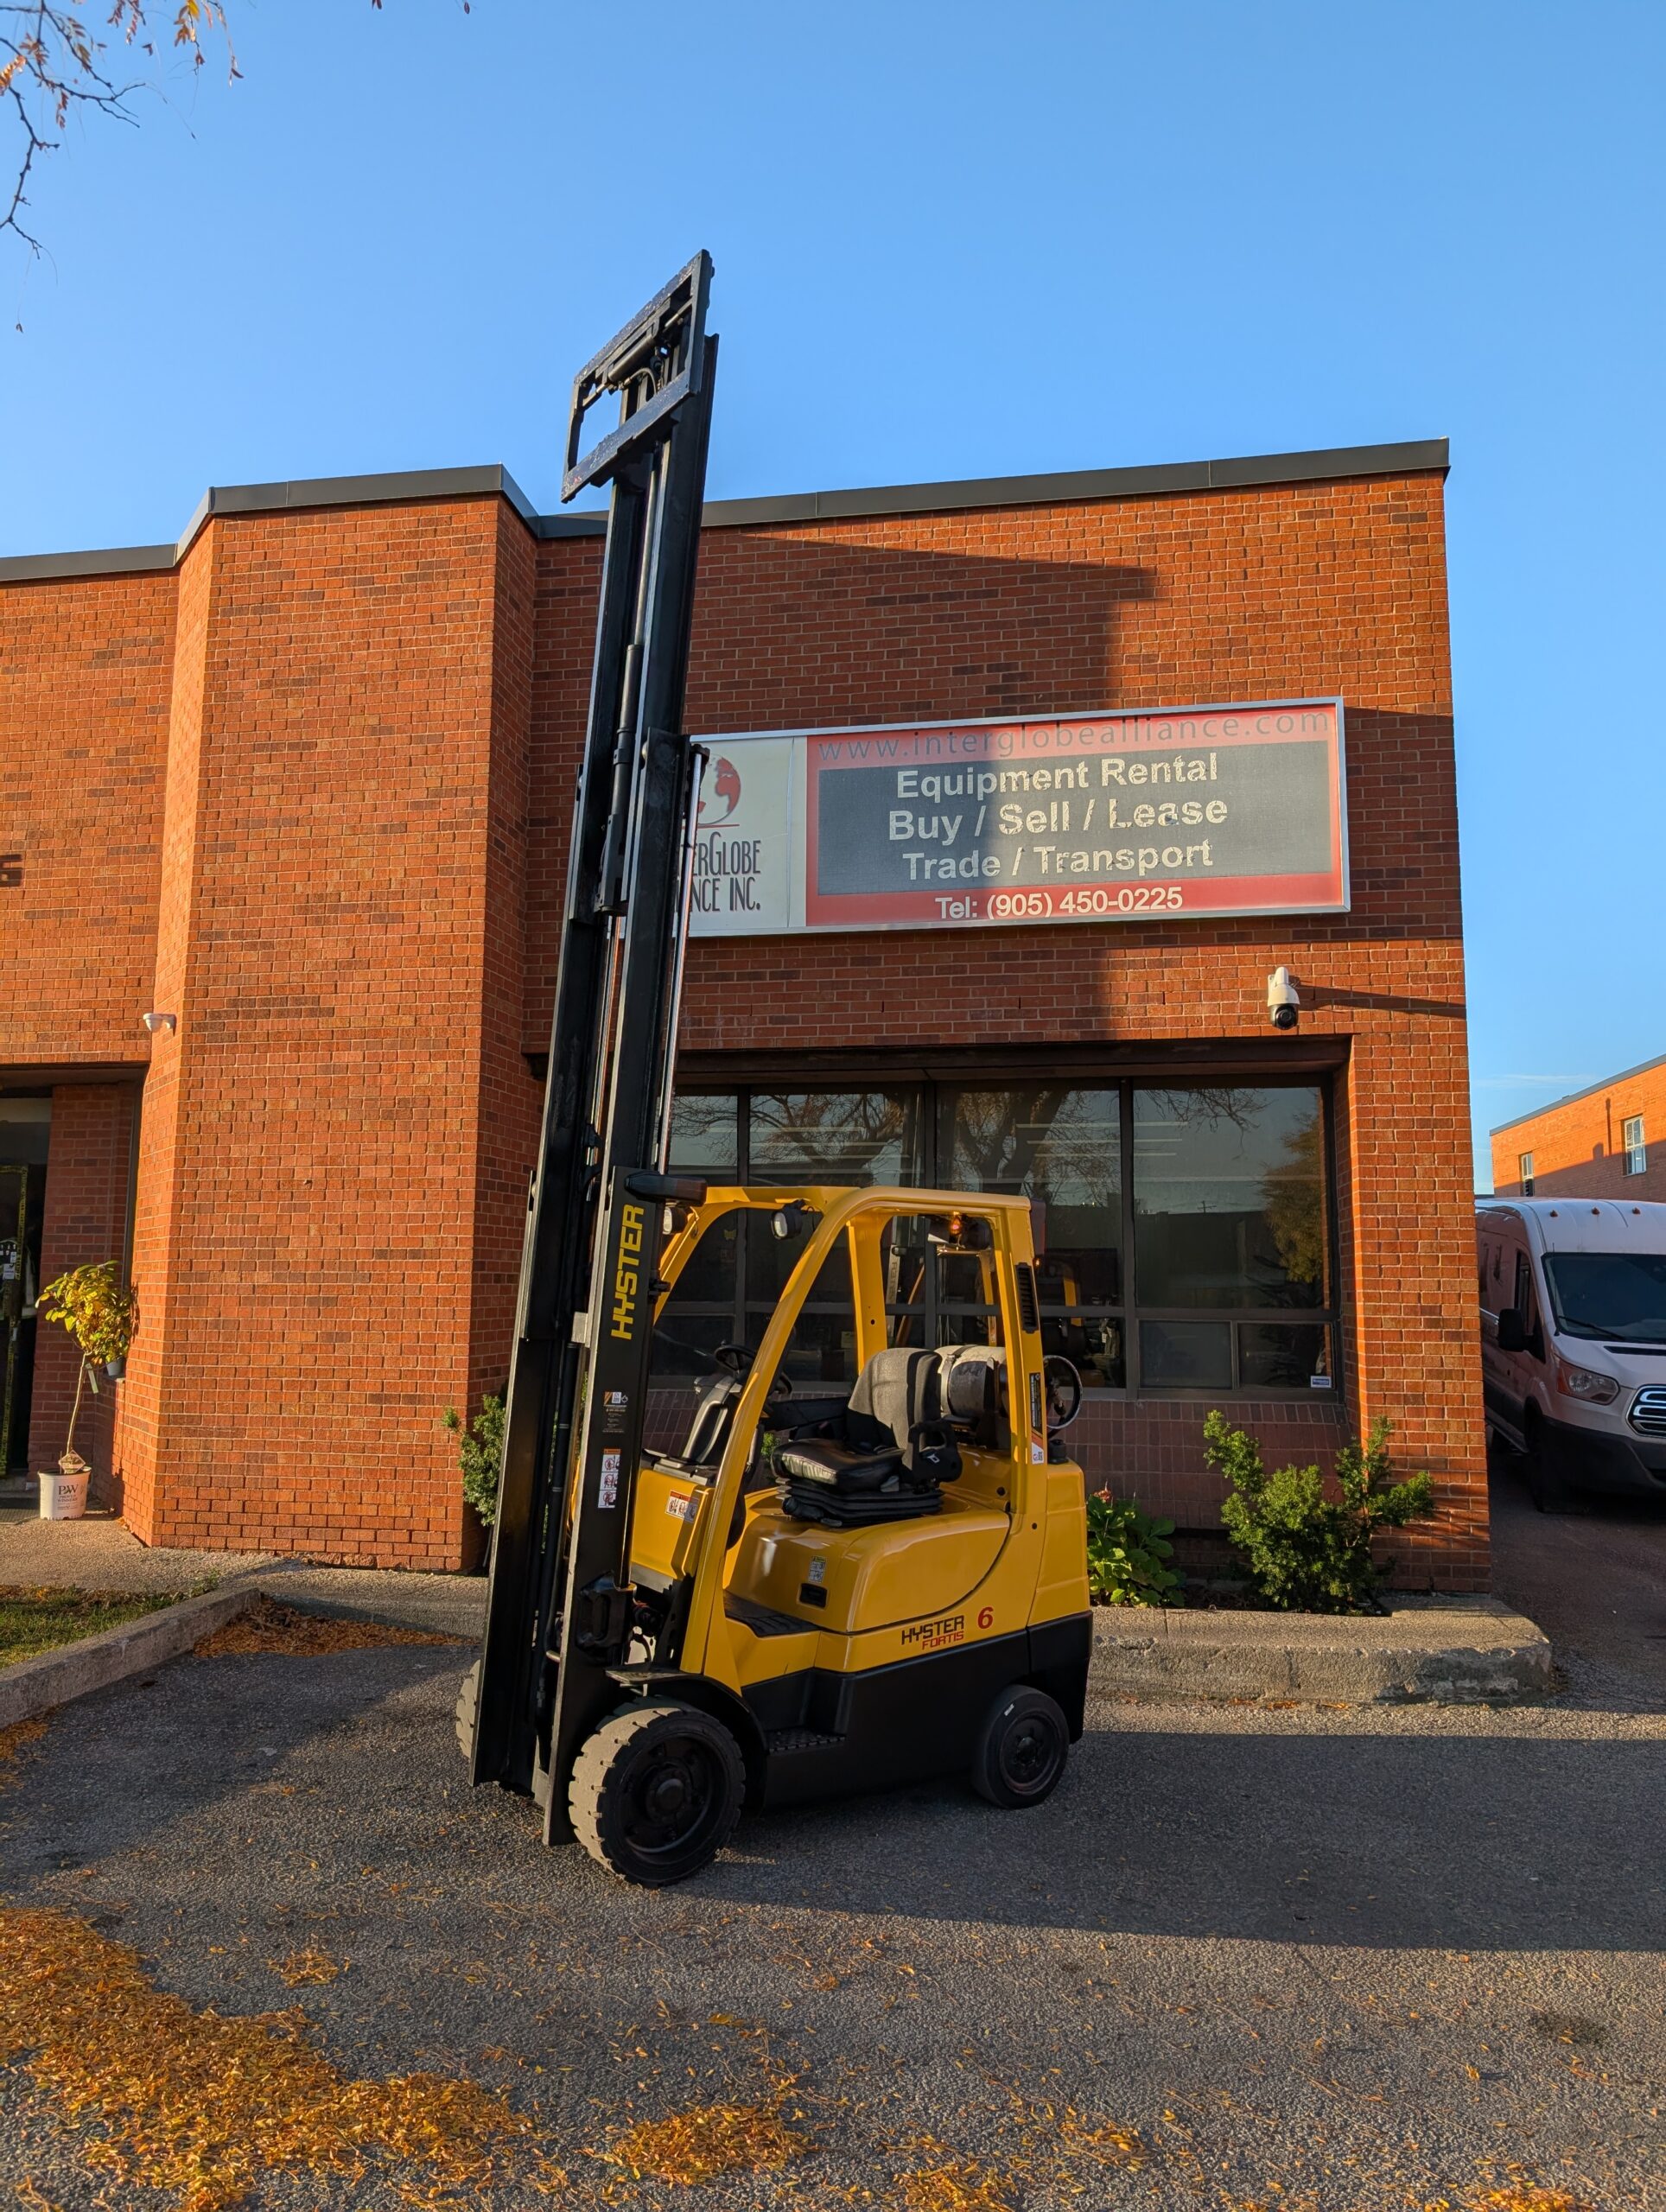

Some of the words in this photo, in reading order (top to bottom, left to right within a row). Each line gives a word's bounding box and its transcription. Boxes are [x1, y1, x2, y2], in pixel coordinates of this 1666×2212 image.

[818, 711, 1328, 761] www.interglobealliance.com
[897, 760, 1089, 804] Equipment
[1101, 753, 1218, 786] Rental
[889, 810, 963, 846] Buy
[974, 805, 987, 836] /
[999, 801, 1070, 835] Sell
[1083, 799, 1096, 830] /
[1109, 798, 1228, 830] Lease
[692, 831, 761, 876] RGLOBE
[903, 850, 1001, 880] Trade
[1012, 847, 1023, 876] /
[1033, 839, 1213, 876] Transport
[729, 876, 761, 912] INC.
[935, 896, 977, 919] Tel:
[987, 892, 1052, 919] (905)
[1059, 887, 1183, 914] 450-0225
[611, 1204, 645, 1340] HYSTER
[901, 1615, 964, 1645] HYSTER
[977, 1606, 994, 1630] 6
[922, 1630, 964, 1649] FORTIS
